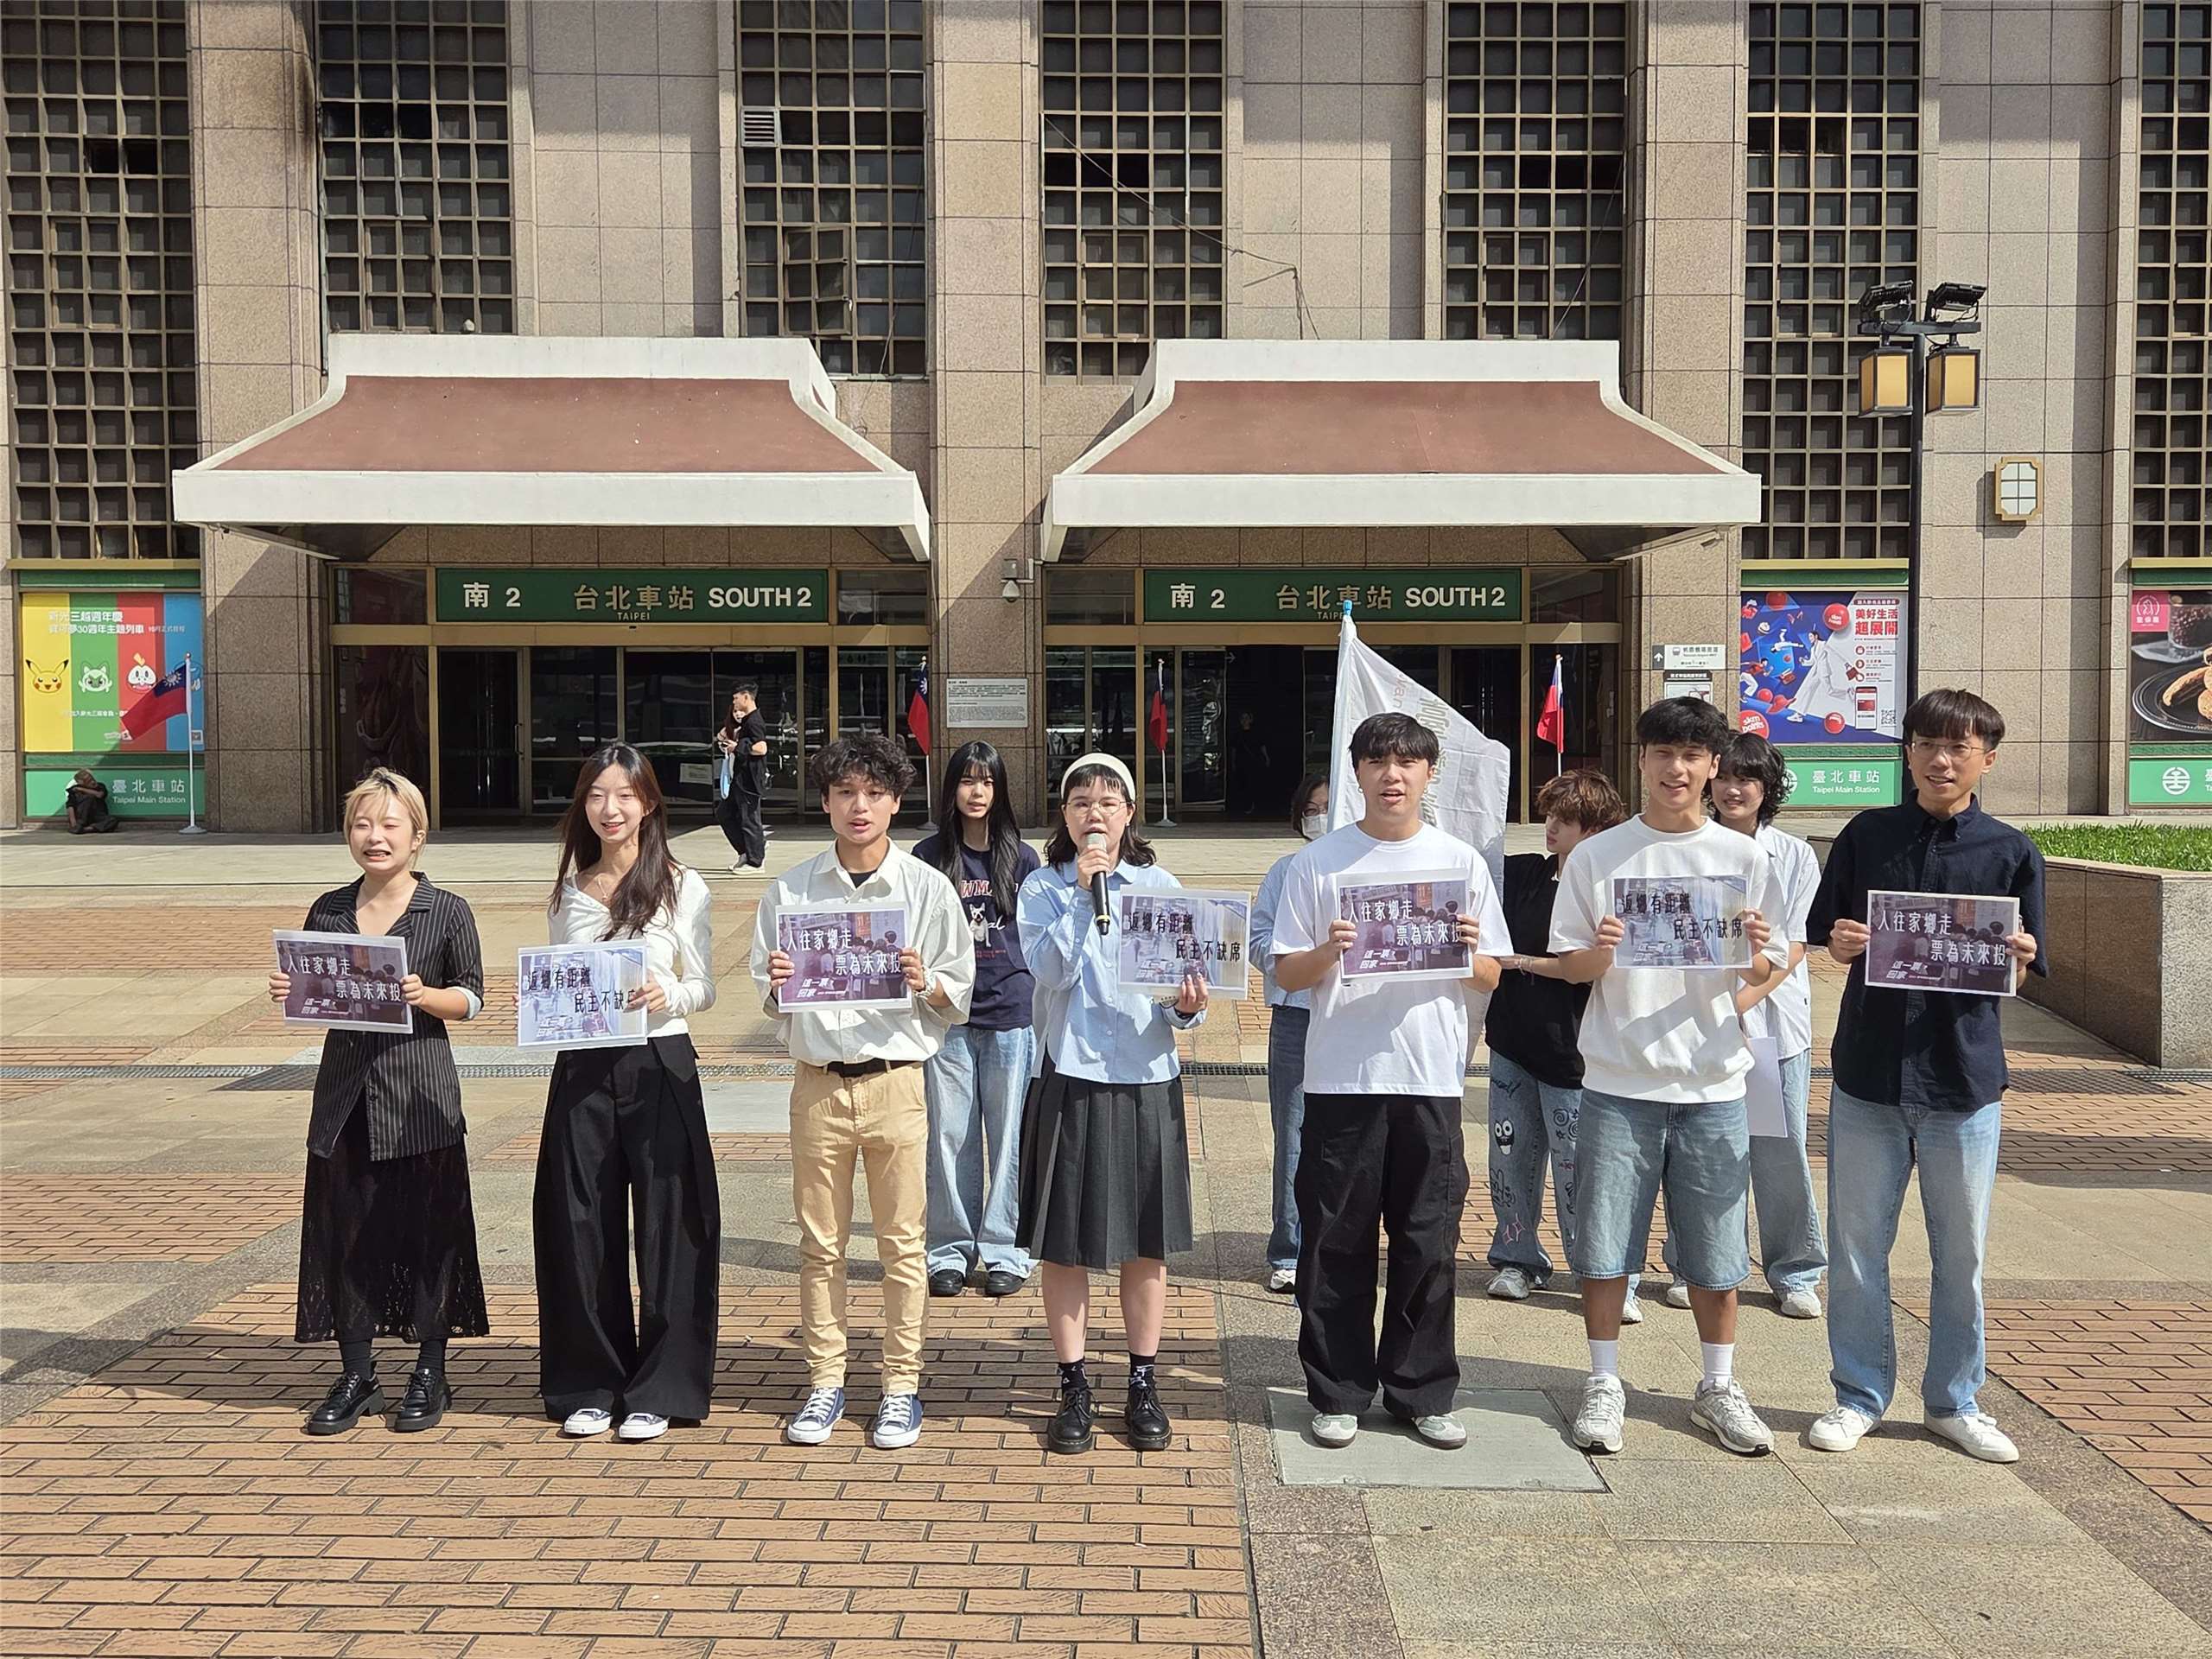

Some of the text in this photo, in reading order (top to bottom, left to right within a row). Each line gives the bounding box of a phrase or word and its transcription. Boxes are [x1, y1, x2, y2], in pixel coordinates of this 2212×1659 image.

[463, 582, 812, 610] 南 2 台北車站 SOUTH 2
[1171, 583, 1505, 609] 南 2 台北車站 SOUTH 2
[617, 612, 650, 620] TAIPEI
[1855, 608, 1898, 620] 美好生活
[112, 779, 185, 793] 臺北車站
[1812, 770, 1880, 784] 臺北車站
[1349, 899, 1413, 923] 人往家鄉走
[1128, 912, 1194, 934] 返鄉有距離
[1674, 918, 1742, 940] 民主不缺席
[1878, 910, 1952, 935] 人往家鄉走
[787, 928, 852, 950] 人往家鄉走
[1176, 938, 1241, 963] 民主不缺席
[1930, 939, 2006, 967] 票為未來投
[287, 955, 353, 976] 人往家鄉走
[836, 951, 901, 976] 票為未來投
[335, 980, 401, 1001] 票為未來投
